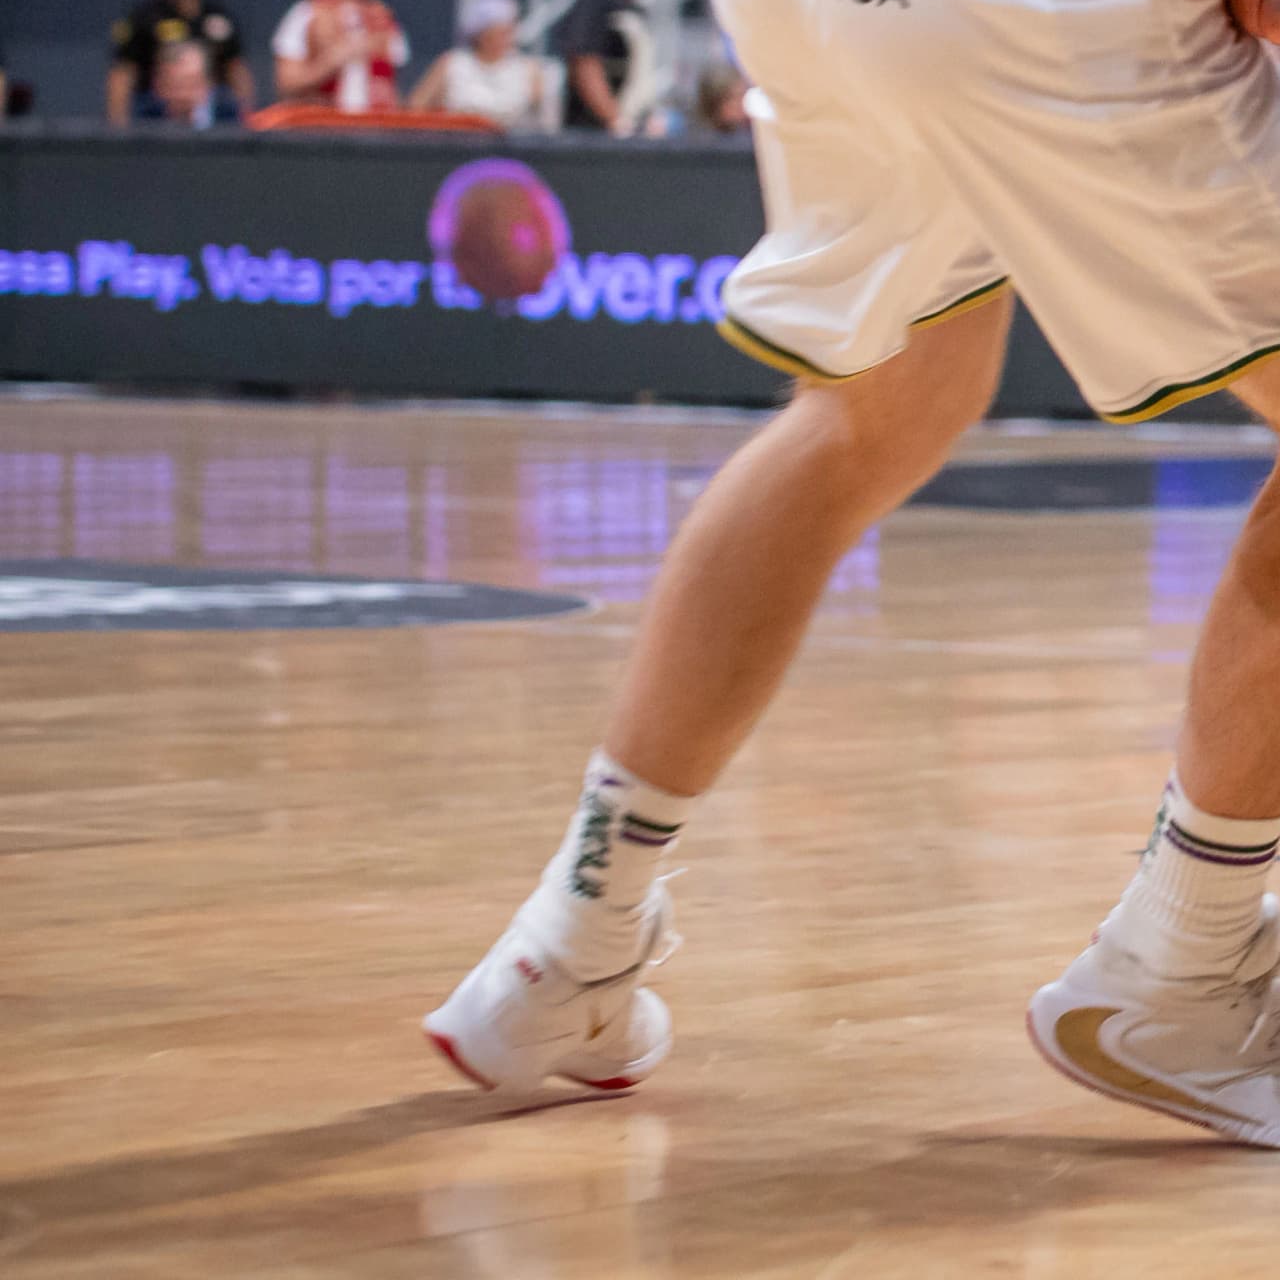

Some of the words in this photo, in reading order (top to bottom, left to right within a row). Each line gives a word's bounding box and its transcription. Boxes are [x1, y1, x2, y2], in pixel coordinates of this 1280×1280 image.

[0, 248, 74, 297] esa
[201, 243, 326, 304] Vota
[328, 258, 427, 319] por
